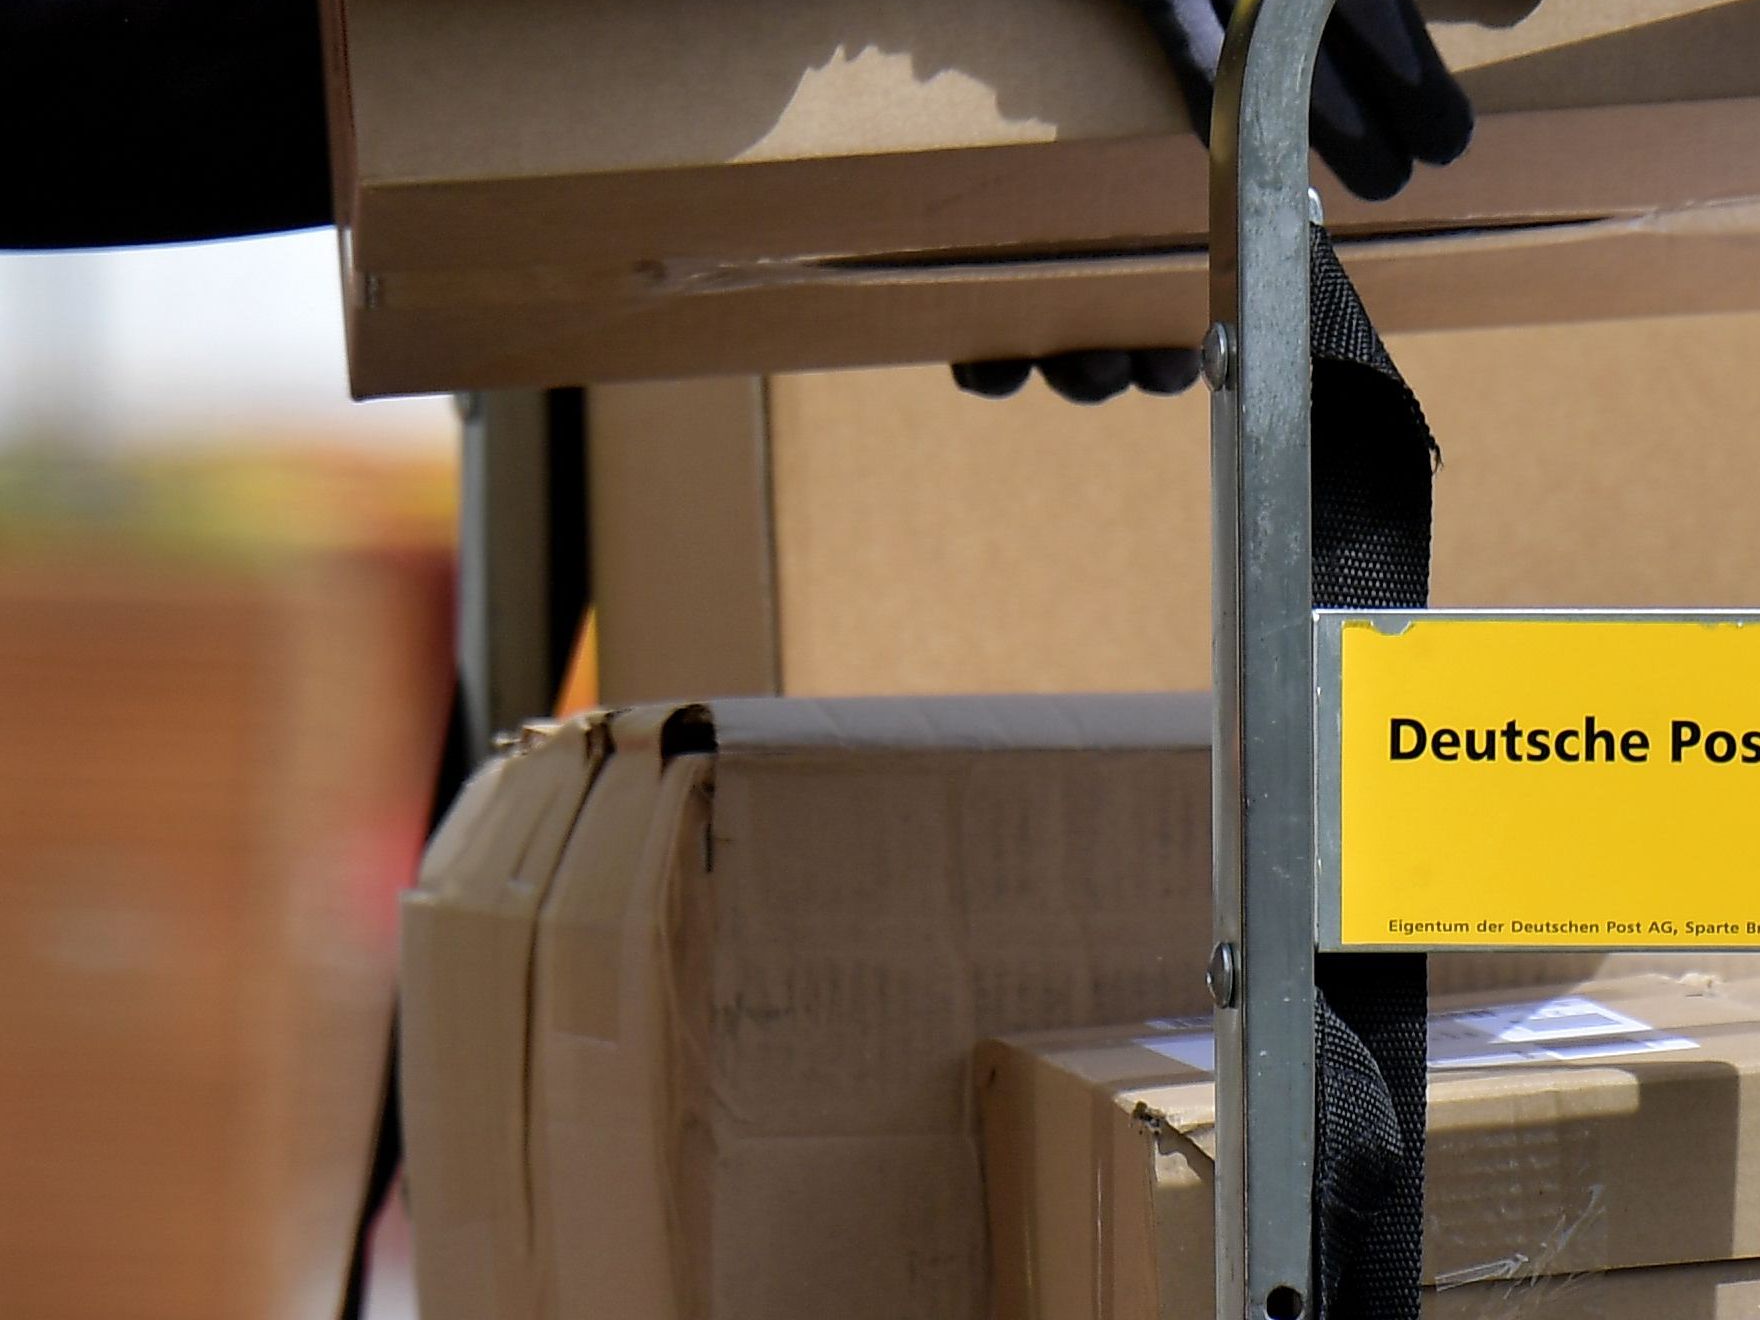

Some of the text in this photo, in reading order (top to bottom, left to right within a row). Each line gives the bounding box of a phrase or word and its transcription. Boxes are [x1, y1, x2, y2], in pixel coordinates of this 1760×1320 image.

[1390, 716, 1649, 763] Deutsche
[1388, 919, 1470, 936] Eigentum
[1476, 919, 1504, 934] der
[1511, 920, 1599, 934] Deutschen
[1606, 920, 1642, 935] Post
[1648, 921, 1678, 936] AG,
[1685, 920, 1740, 937] Sparte
